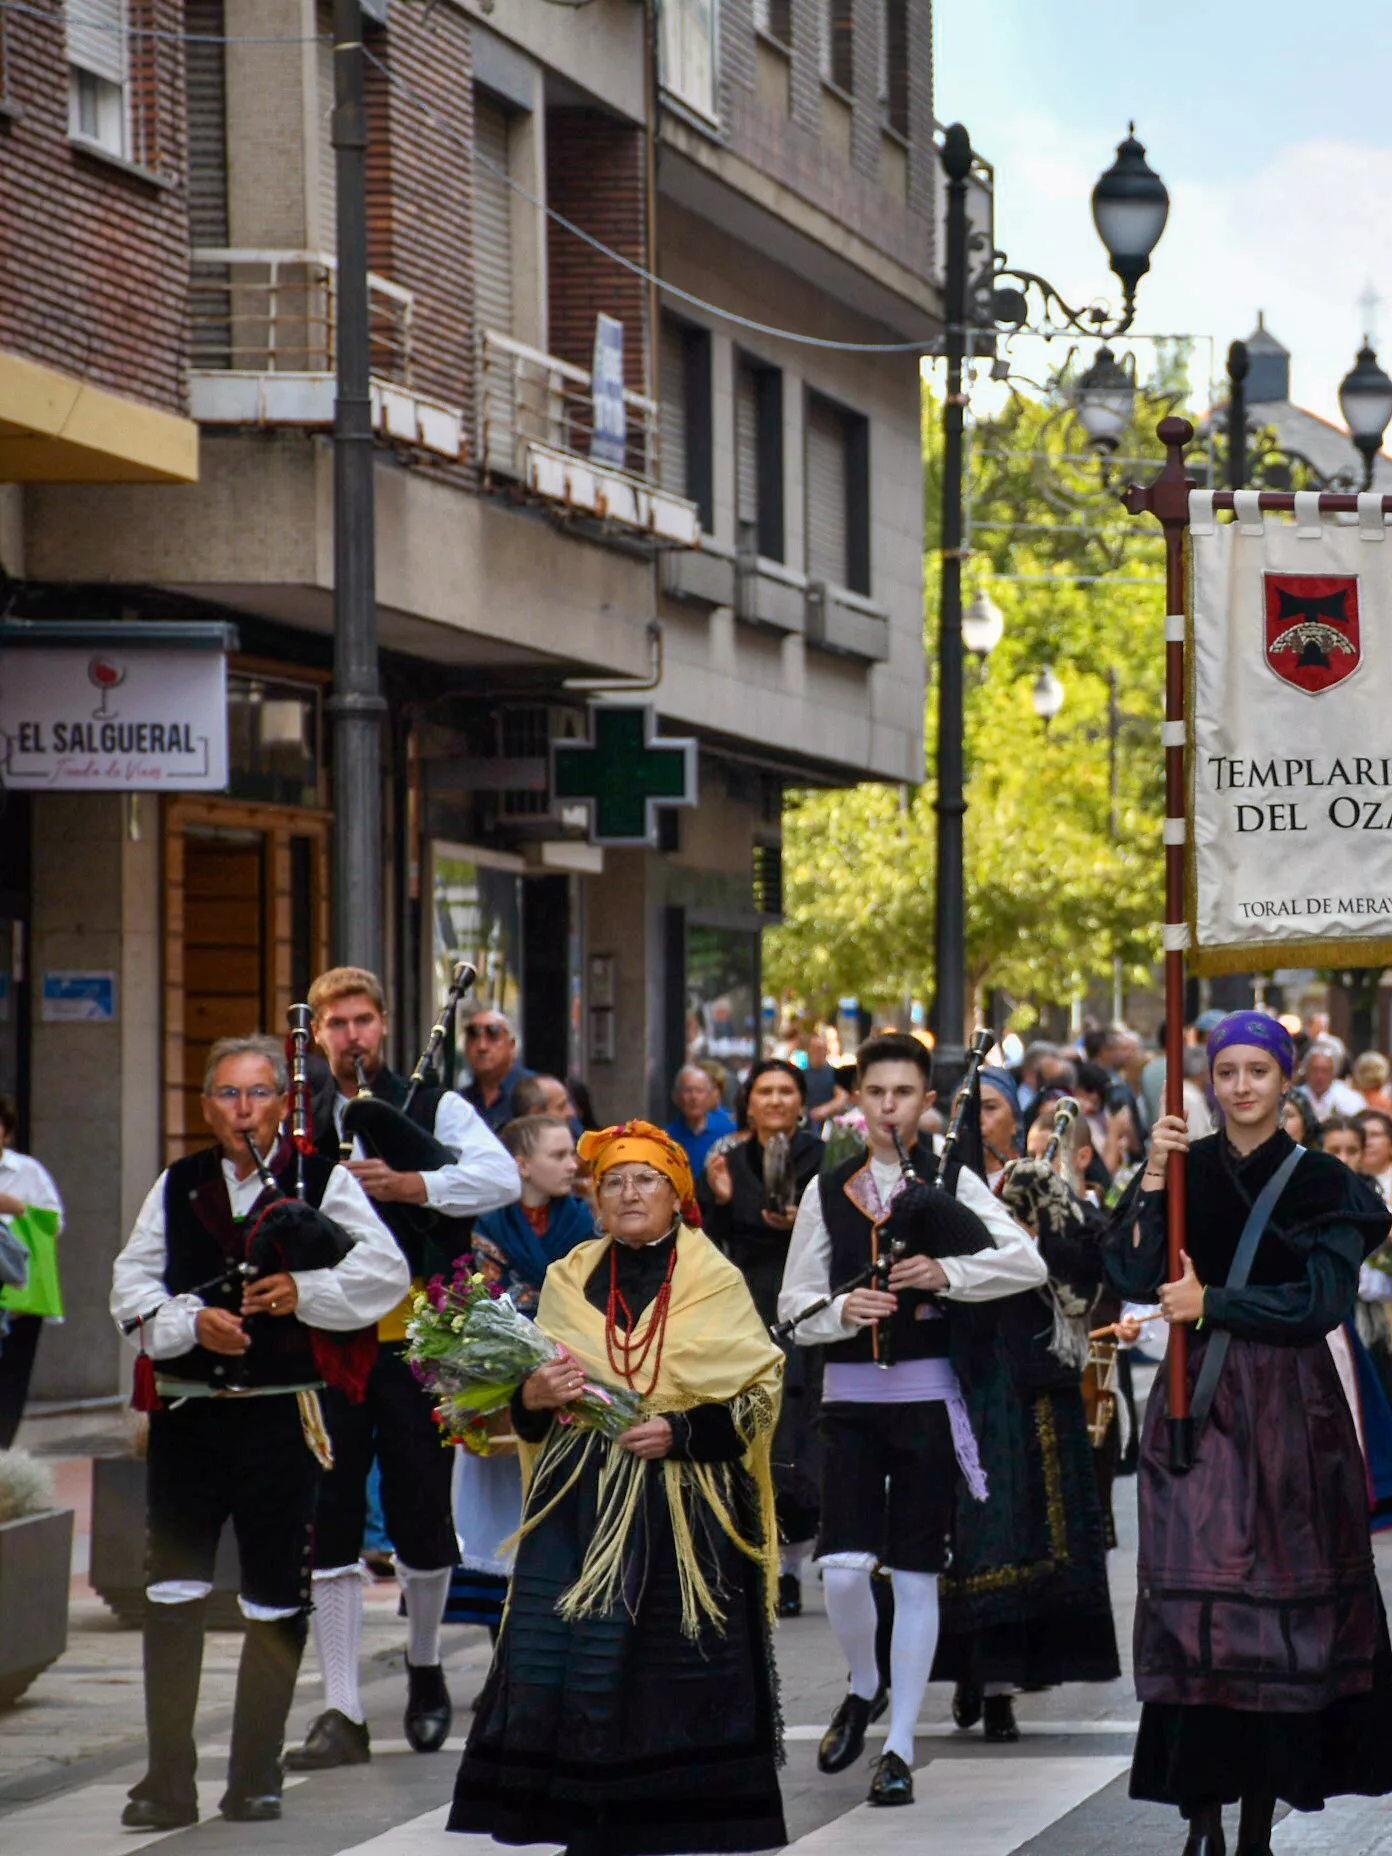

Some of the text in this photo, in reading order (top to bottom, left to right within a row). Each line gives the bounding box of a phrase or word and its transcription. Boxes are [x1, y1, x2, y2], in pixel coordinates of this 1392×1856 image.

[19, 721, 196, 753] EL SALGUERAL
[1234, 803, 1308, 833] DEL
[1239, 899, 1302, 918] TORAL
[1306, 898, 1333, 915] DE
